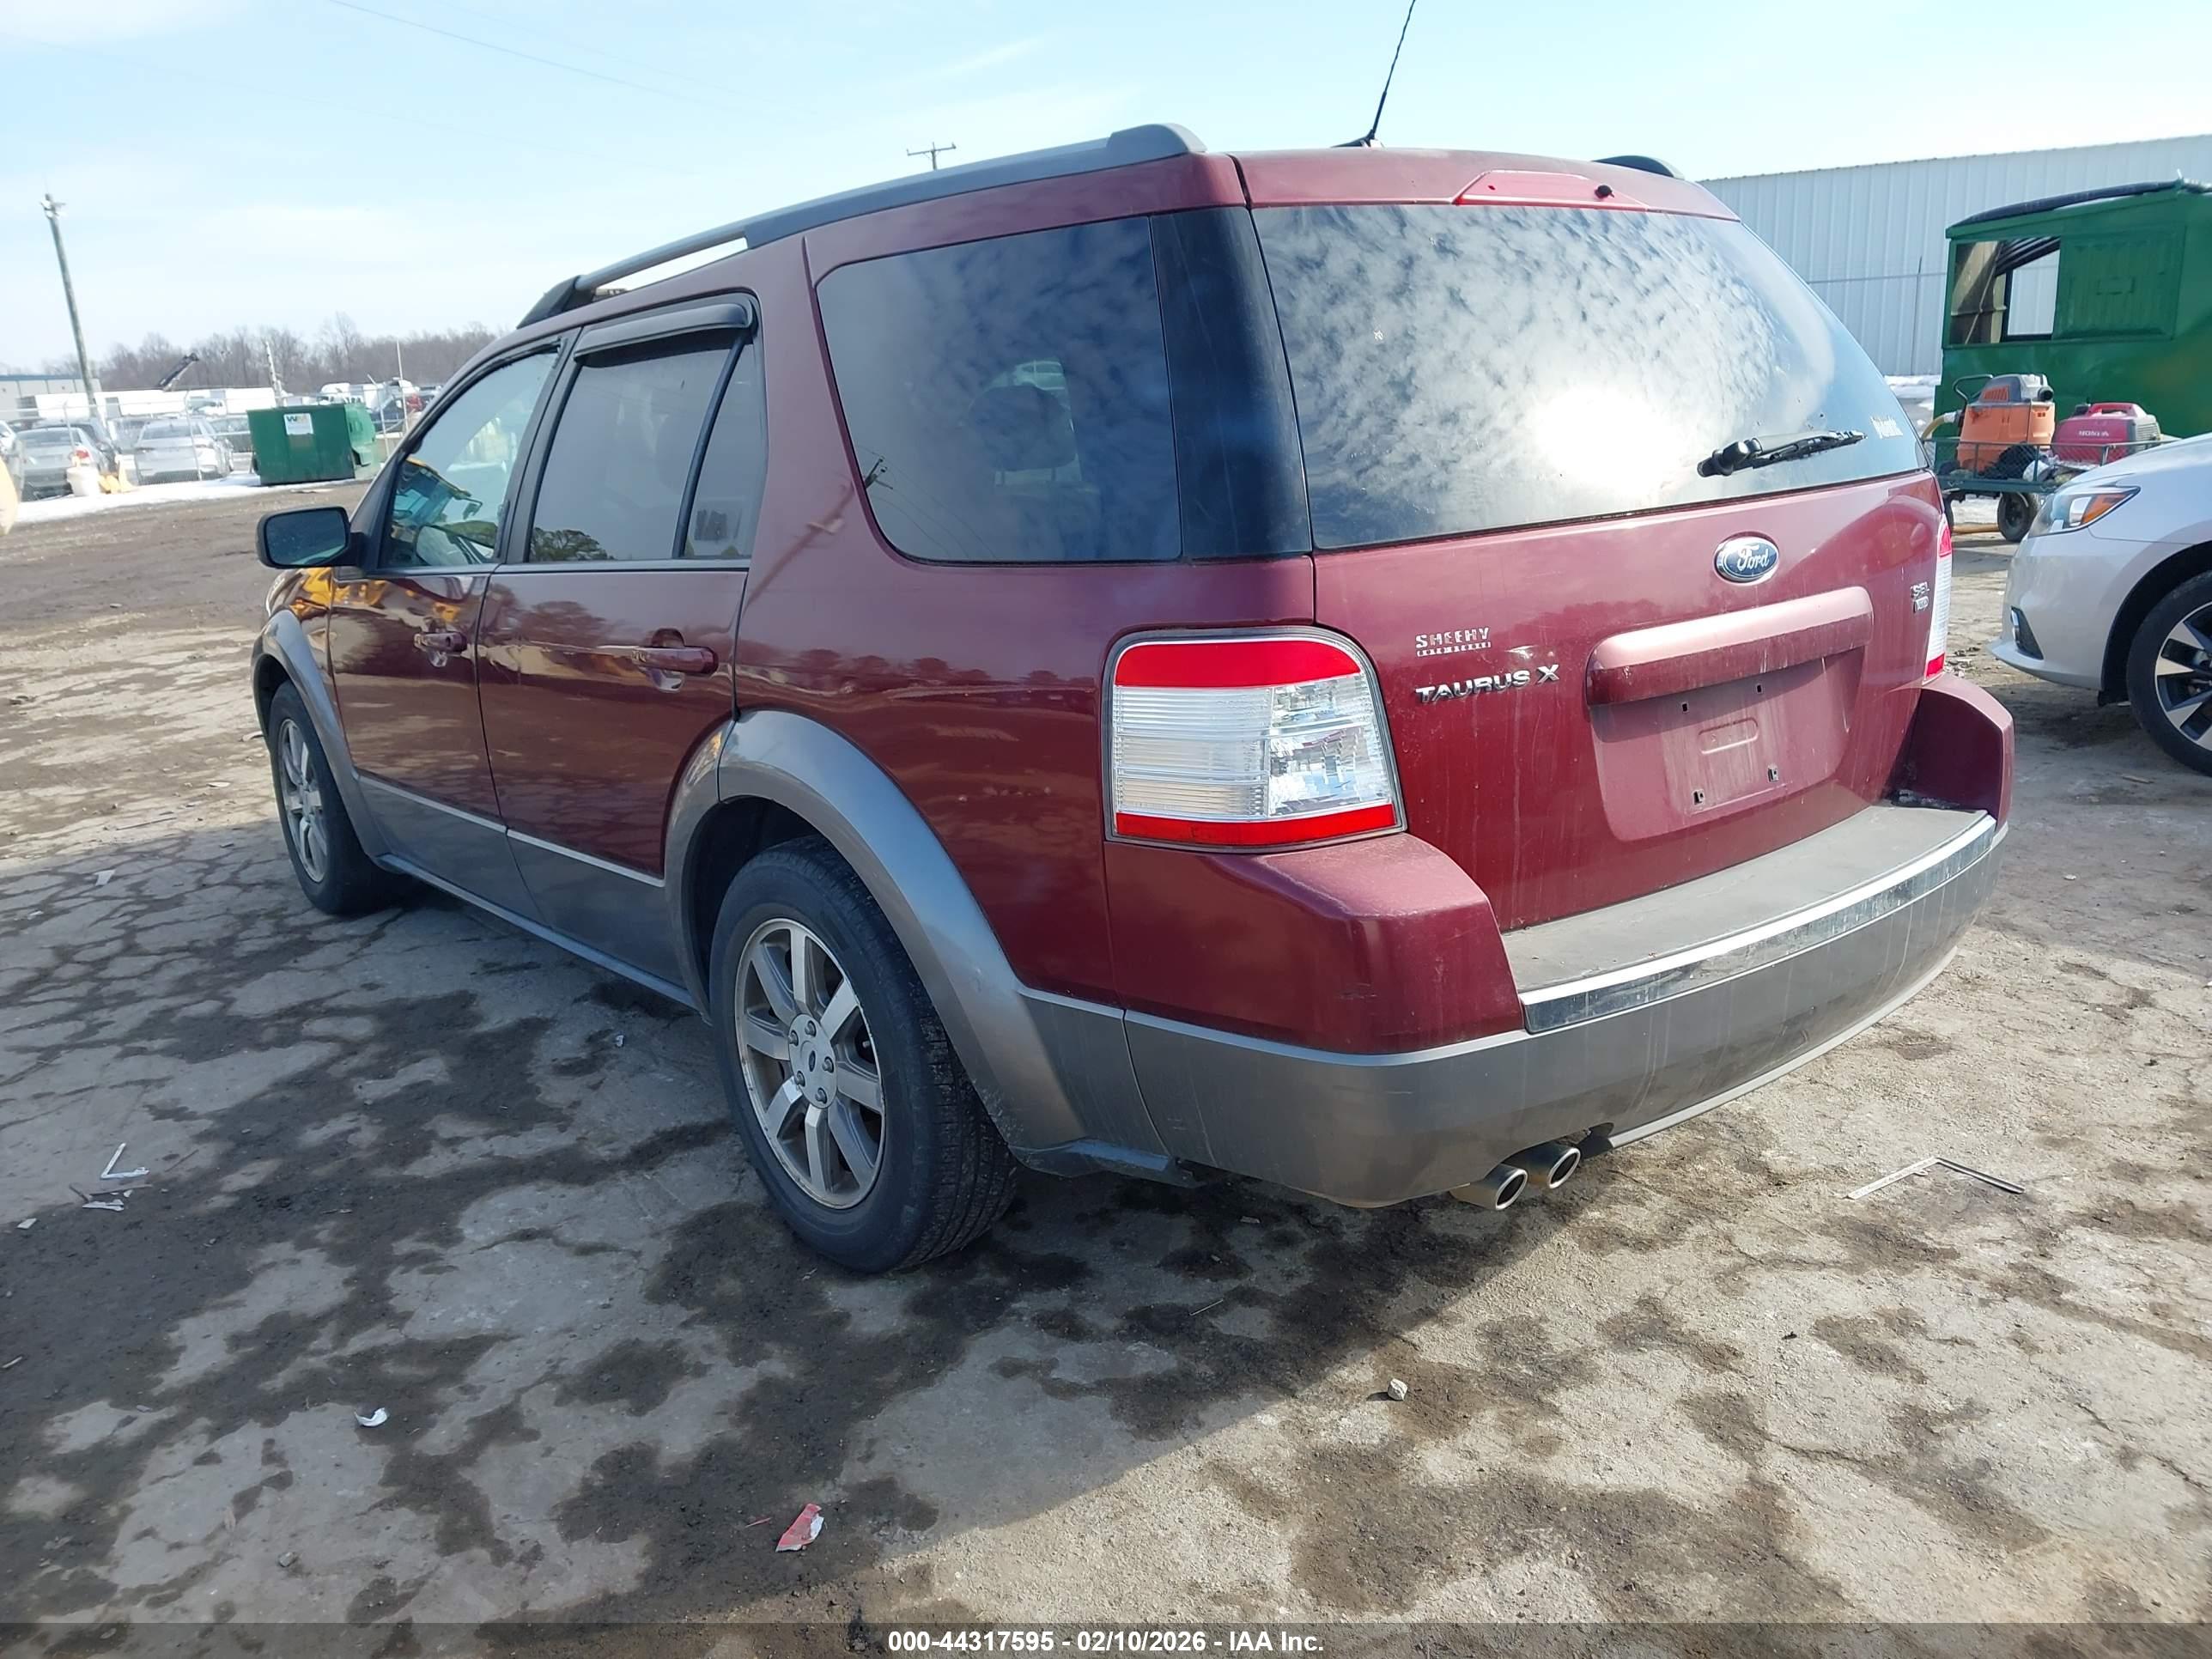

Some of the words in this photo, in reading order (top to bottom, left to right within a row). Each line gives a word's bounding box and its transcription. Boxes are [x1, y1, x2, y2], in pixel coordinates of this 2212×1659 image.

[1737, 544, 1770, 572] Ford
[1415, 627, 1490, 649] SHEEHY
[1415, 670, 1531, 704] TAURUS
[1537, 664, 1560, 684] X
